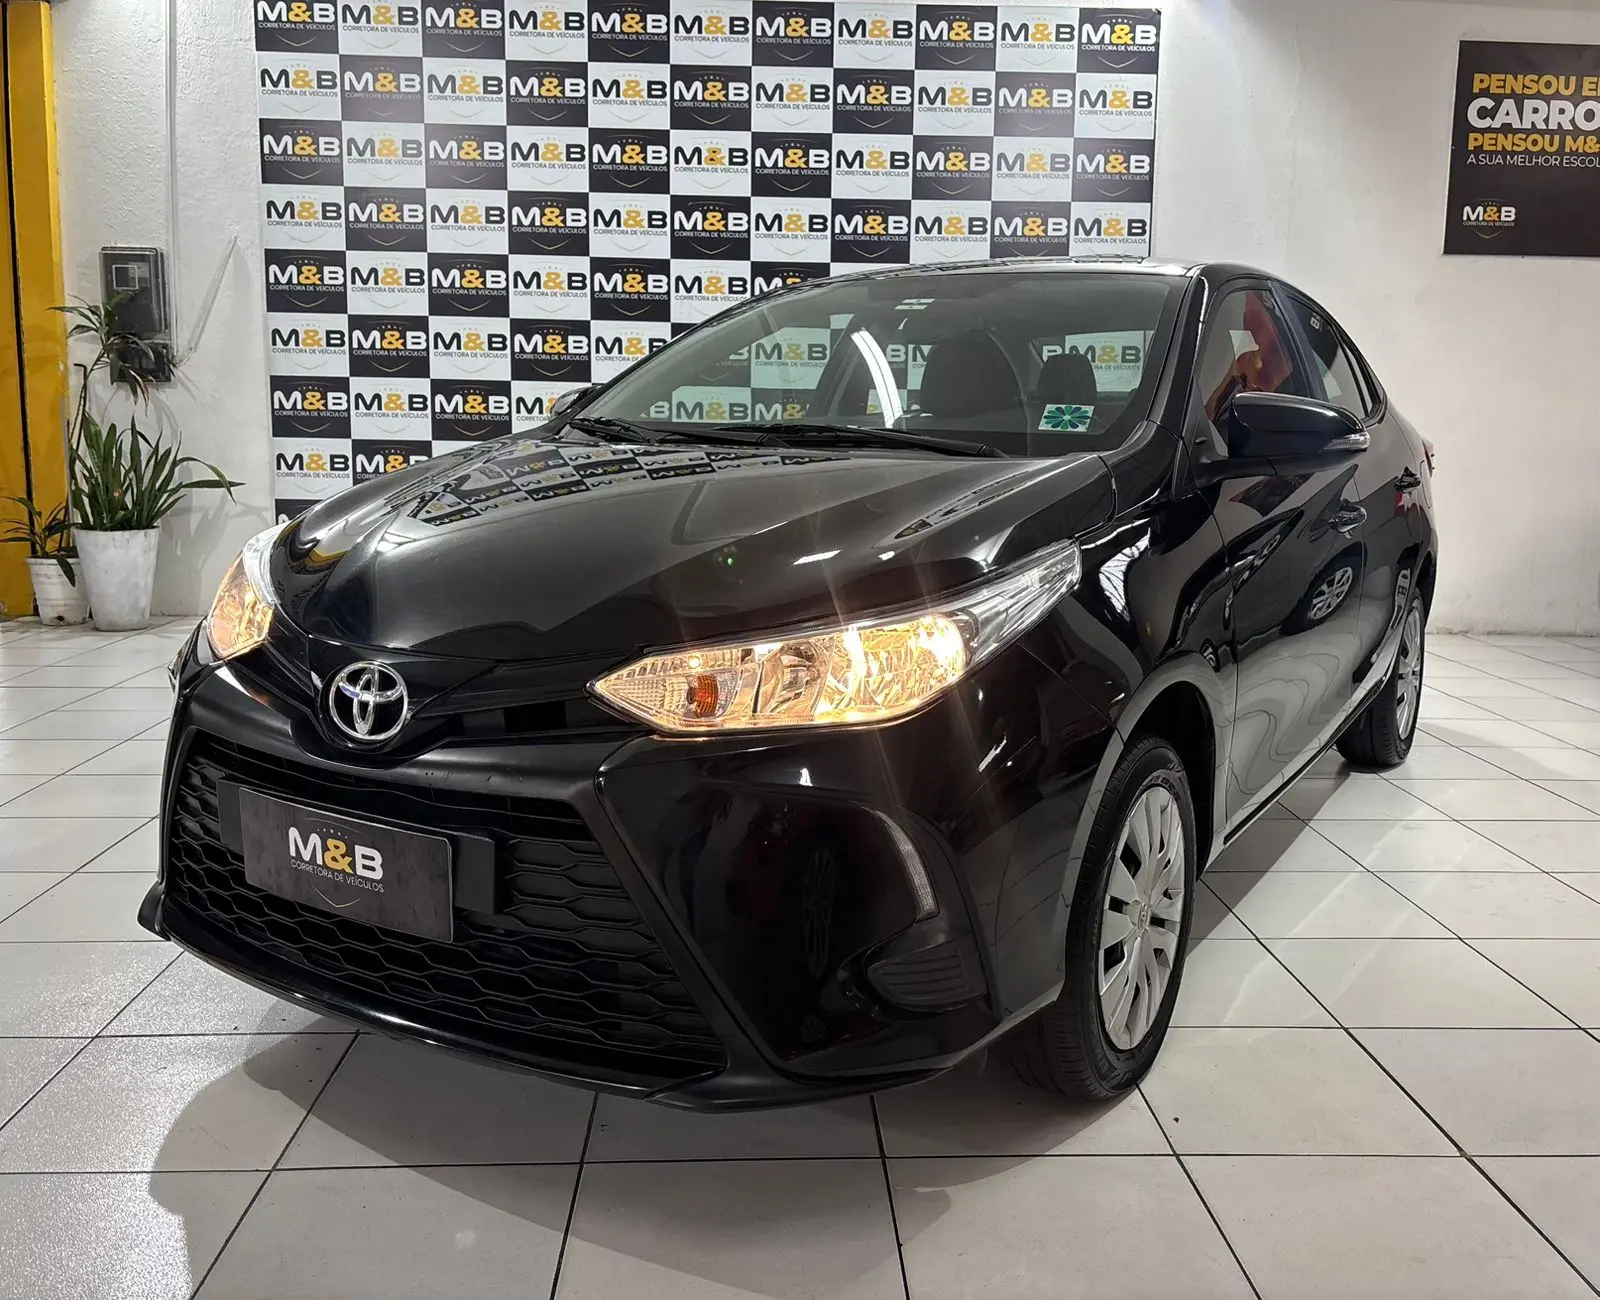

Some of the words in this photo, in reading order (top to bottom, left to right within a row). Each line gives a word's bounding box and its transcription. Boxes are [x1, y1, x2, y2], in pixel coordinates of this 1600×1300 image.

[259, 2, 335, 23] M&B
[342, 4, 418, 26] M&B
[426, 7, 502, 28] M&B
[509, 10, 584, 31] M&B
[592, 12, 667, 33] M&B
[674, 14, 749, 35] M&B
[756, 16, 831, 37] M&B
[838, 18, 913, 39] M&B
[920, 20, 994, 41] M&B
[1001, 22, 1075, 42] M&B
[1082, 23, 1156, 43] M&B
[261, 68, 337, 90] M&B
[344, 71, 420, 92] M&B
[427, 74, 503, 95] M&B
[510, 76, 585, 97] M&B
[592, 79, 667, 99] M&B
[1473, 74, 1576, 96] PENSOU
[1582, 76, 1600, 96] E
[674, 81, 749, 101] M&B
[756, 83, 830, 103] M&B
[837, 84, 911, 105] M&B
[918, 86, 992, 106] M&B
[999, 88, 1072, 107] M&B
[1079, 89, 1153, 109] M&B
[1467, 98, 1600, 130] CARRO
[264, 135, 340, 155] M&B
[346, 137, 422, 158] M&B
[429, 140, 504, 160] M&B
[511, 142, 586, 162] M&B
[1468, 133, 1560, 152] PENSOU
[593, 144, 667, 164] M&B
[674, 146, 749, 166] M&B
[755, 148, 829, 168] M&B
[836, 150, 910, 170] M&B
[917, 151, 990, 171] M&B
[997, 153, 1070, 172] M&B
[1077, 154, 1150, 173] M&B
[1467, 154, 1476, 164] A
[1479, 155, 1503, 165] SUA
[1507, 155, 1560, 166] MELHOR
[266, 200, 342, 220] M&B
[348, 202, 424, 223] M&B
[430, 205, 505, 225] M&B
[512, 207, 587, 227] M&B
[593, 209, 668, 229] M&B
[1463, 206, 1516, 221] M&B
[674, 211, 748, 231] M&B
[755, 212, 829, 232] M&B
[835, 214, 909, 234] M&B
[915, 216, 988, 235] M&B
[995, 217, 1068, 236] M&B
[1074, 218, 1147, 237] M&B
[269, 264, 344, 284] M&B
[350, 267, 426, 286] M&B
[432, 269, 507, 289] M&B
[513, 271, 587, 291] M&B
[594, 273, 668, 293] M&B
[674, 274, 748, 294] M&B
[271, 328, 346, 347] M&B
[352, 330, 427, 349] M&B
[433, 332, 508, 352] M&B
[514, 334, 588, 354] M&B
[754, 342, 827, 360] M&B
[273, 391, 348, 409] M&B
[354, 393, 429, 412] M&B
[435, 394, 509, 414] M&B
[676, 401, 749, 420] M&B
[276, 453, 350, 471] M&B
[288, 827, 384, 880] M&B
[290, 860, 333, 879] CORRETORA
[334, 871, 344, 883] DE
[346, 874, 384, 892] VEÍCULOS
